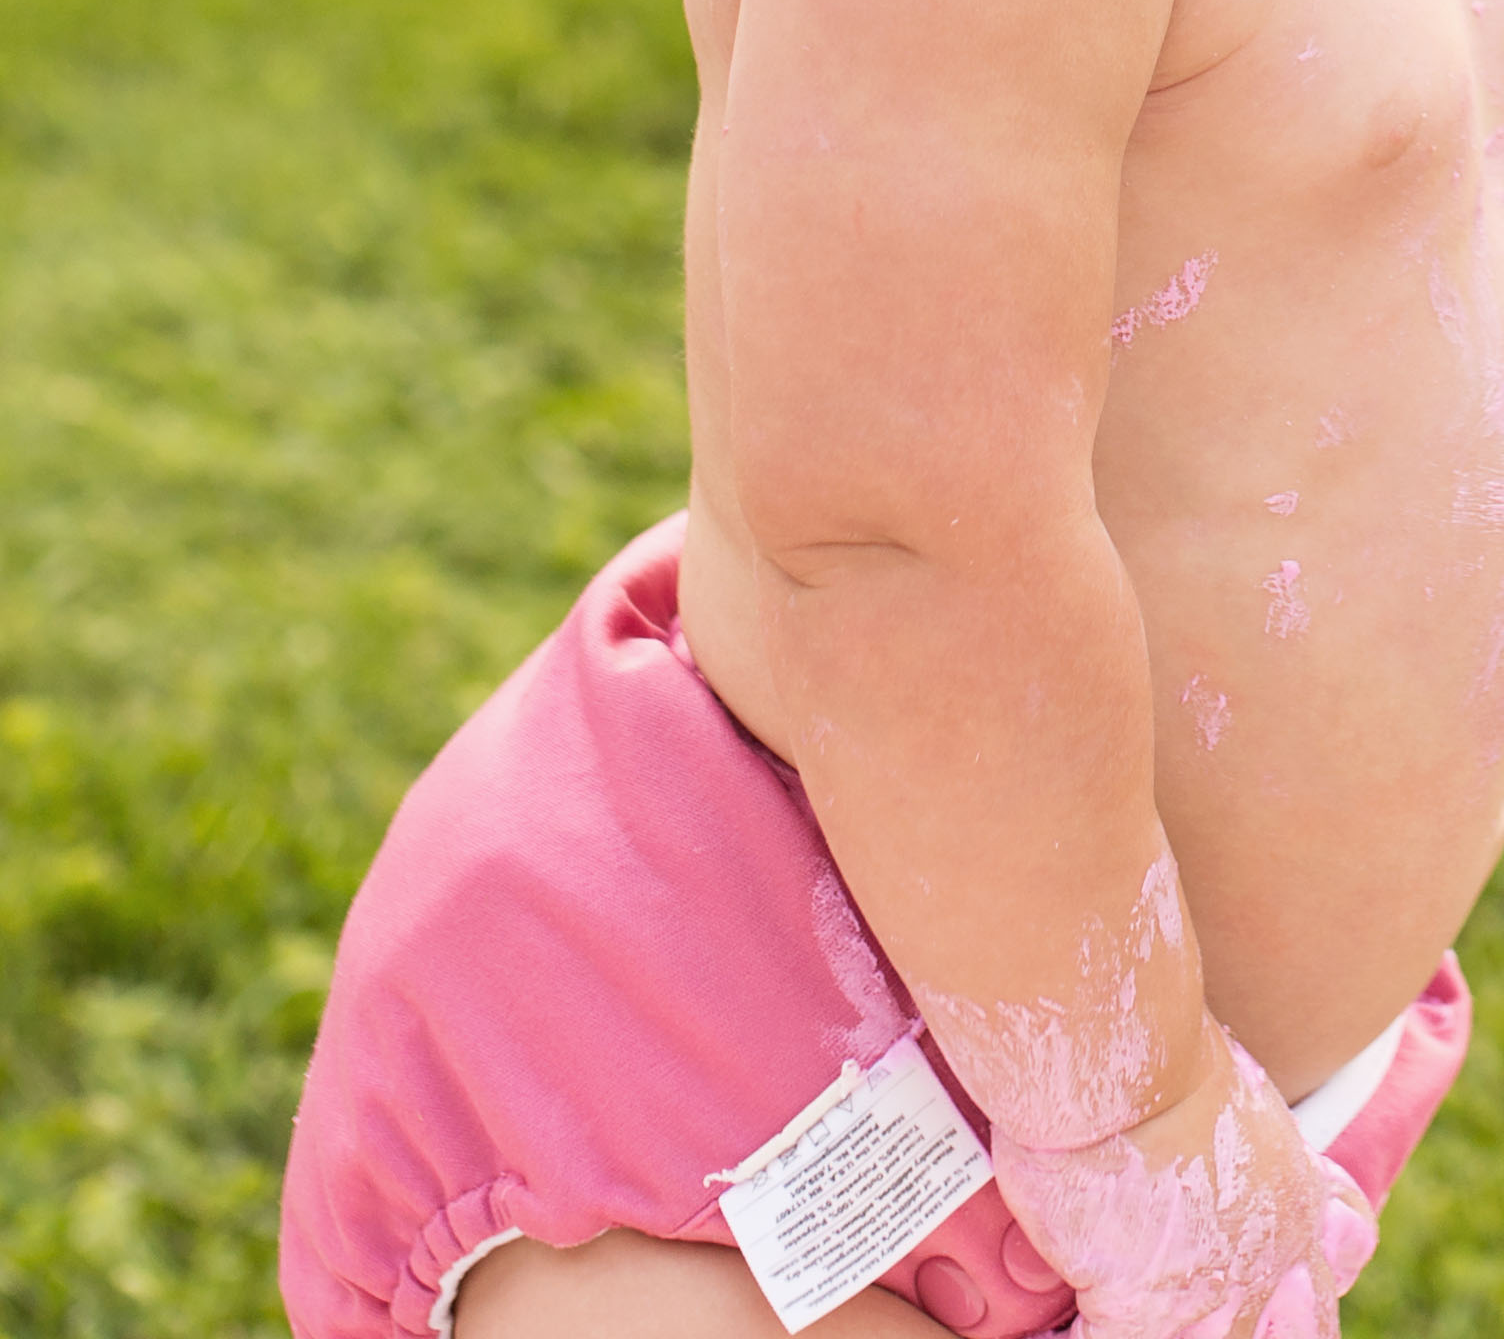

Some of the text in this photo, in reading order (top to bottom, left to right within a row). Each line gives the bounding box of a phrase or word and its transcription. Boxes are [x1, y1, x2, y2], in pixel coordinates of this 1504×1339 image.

[880, 1113, 905, 1136] Made
[943, 1127, 957, 1140] No
[850, 1122, 880, 1150] Patent
[870, 1136, 881, 1147] in
[854, 1145, 871, 1160] the
[913, 1138, 944, 1166] laundry
[931, 1145, 954, 1166] Wash
[783, 1133, 925, 1250] Inner and Outer: 100% Polyester
[831, 1162, 878, 1201] Polyester,
[923, 1179, 931, 1190] of
[942, 1175, 951, 1187] of
[816, 1199, 832, 1213] 5%
[888, 1189, 922, 1220] additive
[776, 1211, 816, 1240] Spandex
[869, 1220, 889, 1236] free
[821, 1235, 831, 1244] or
[877, 1227, 914, 1259] laundry
[816, 1241, 880, 1290] recommended
